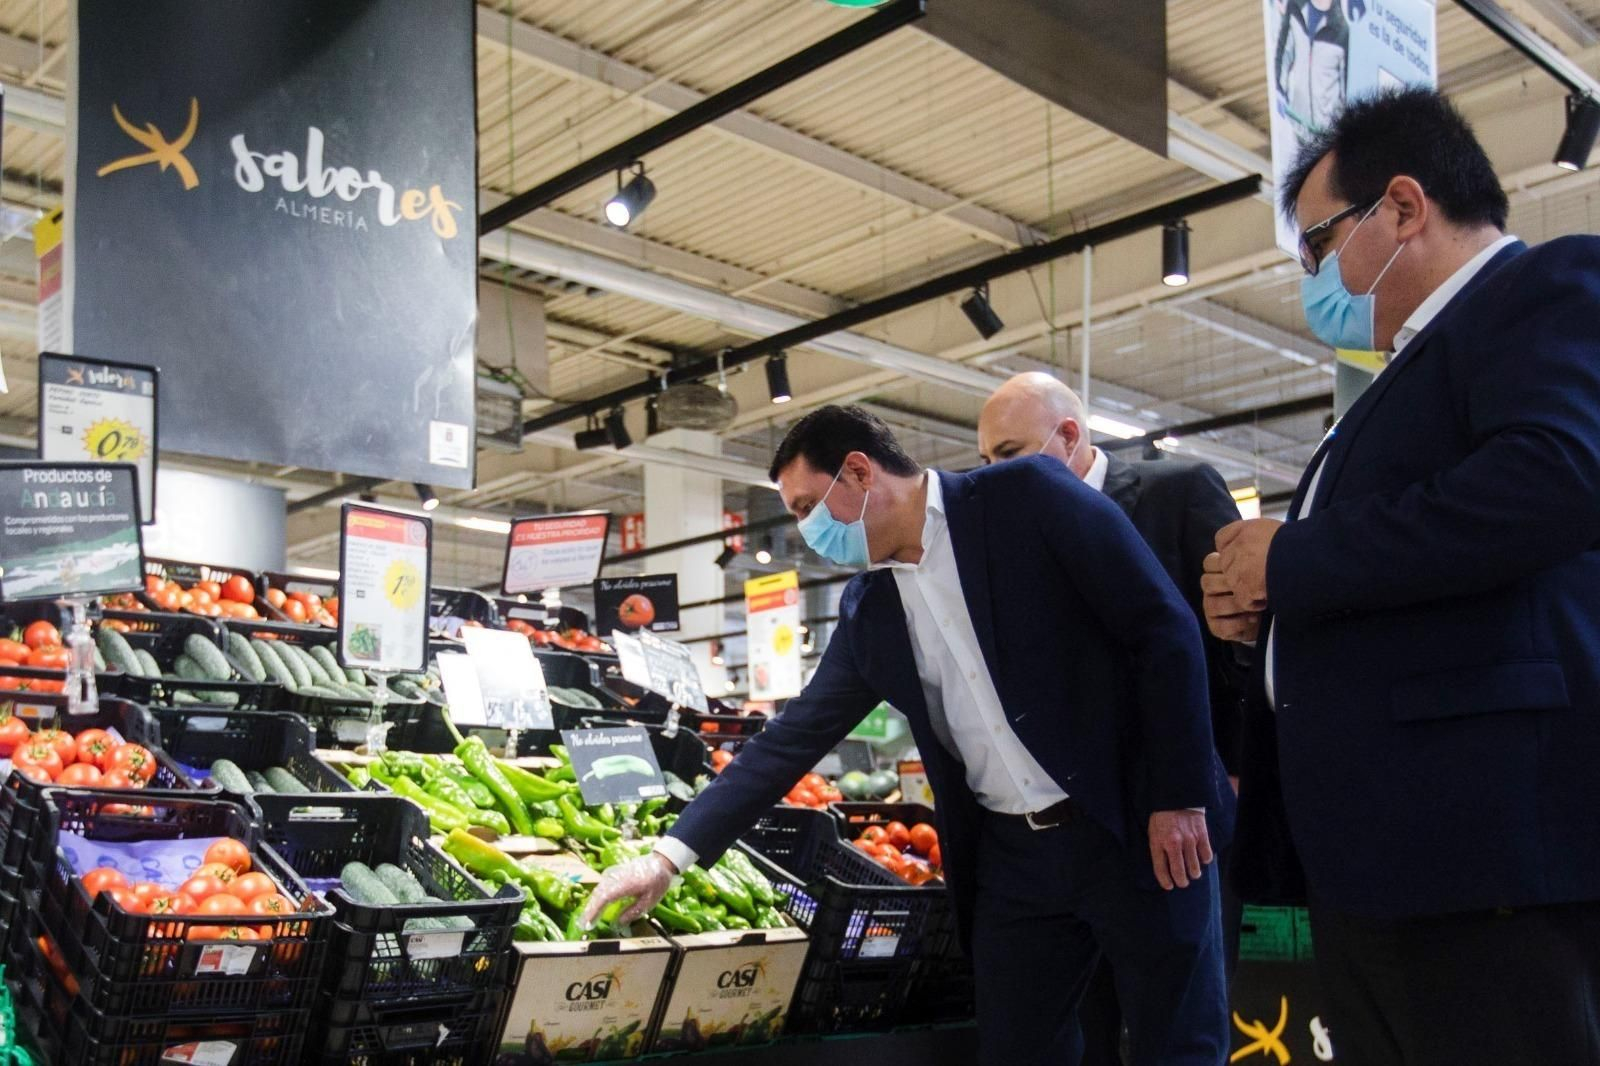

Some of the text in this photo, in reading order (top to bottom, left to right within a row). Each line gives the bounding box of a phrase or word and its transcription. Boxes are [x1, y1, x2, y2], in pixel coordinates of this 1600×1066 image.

[1369, 22, 1430, 76] es la de todos
[275, 197, 369, 232] ALMERÍA
[23, 468, 113, 483] Productos de
[717, 968, 758, 989] CASI
[565, 979, 612, 1001] CASI
